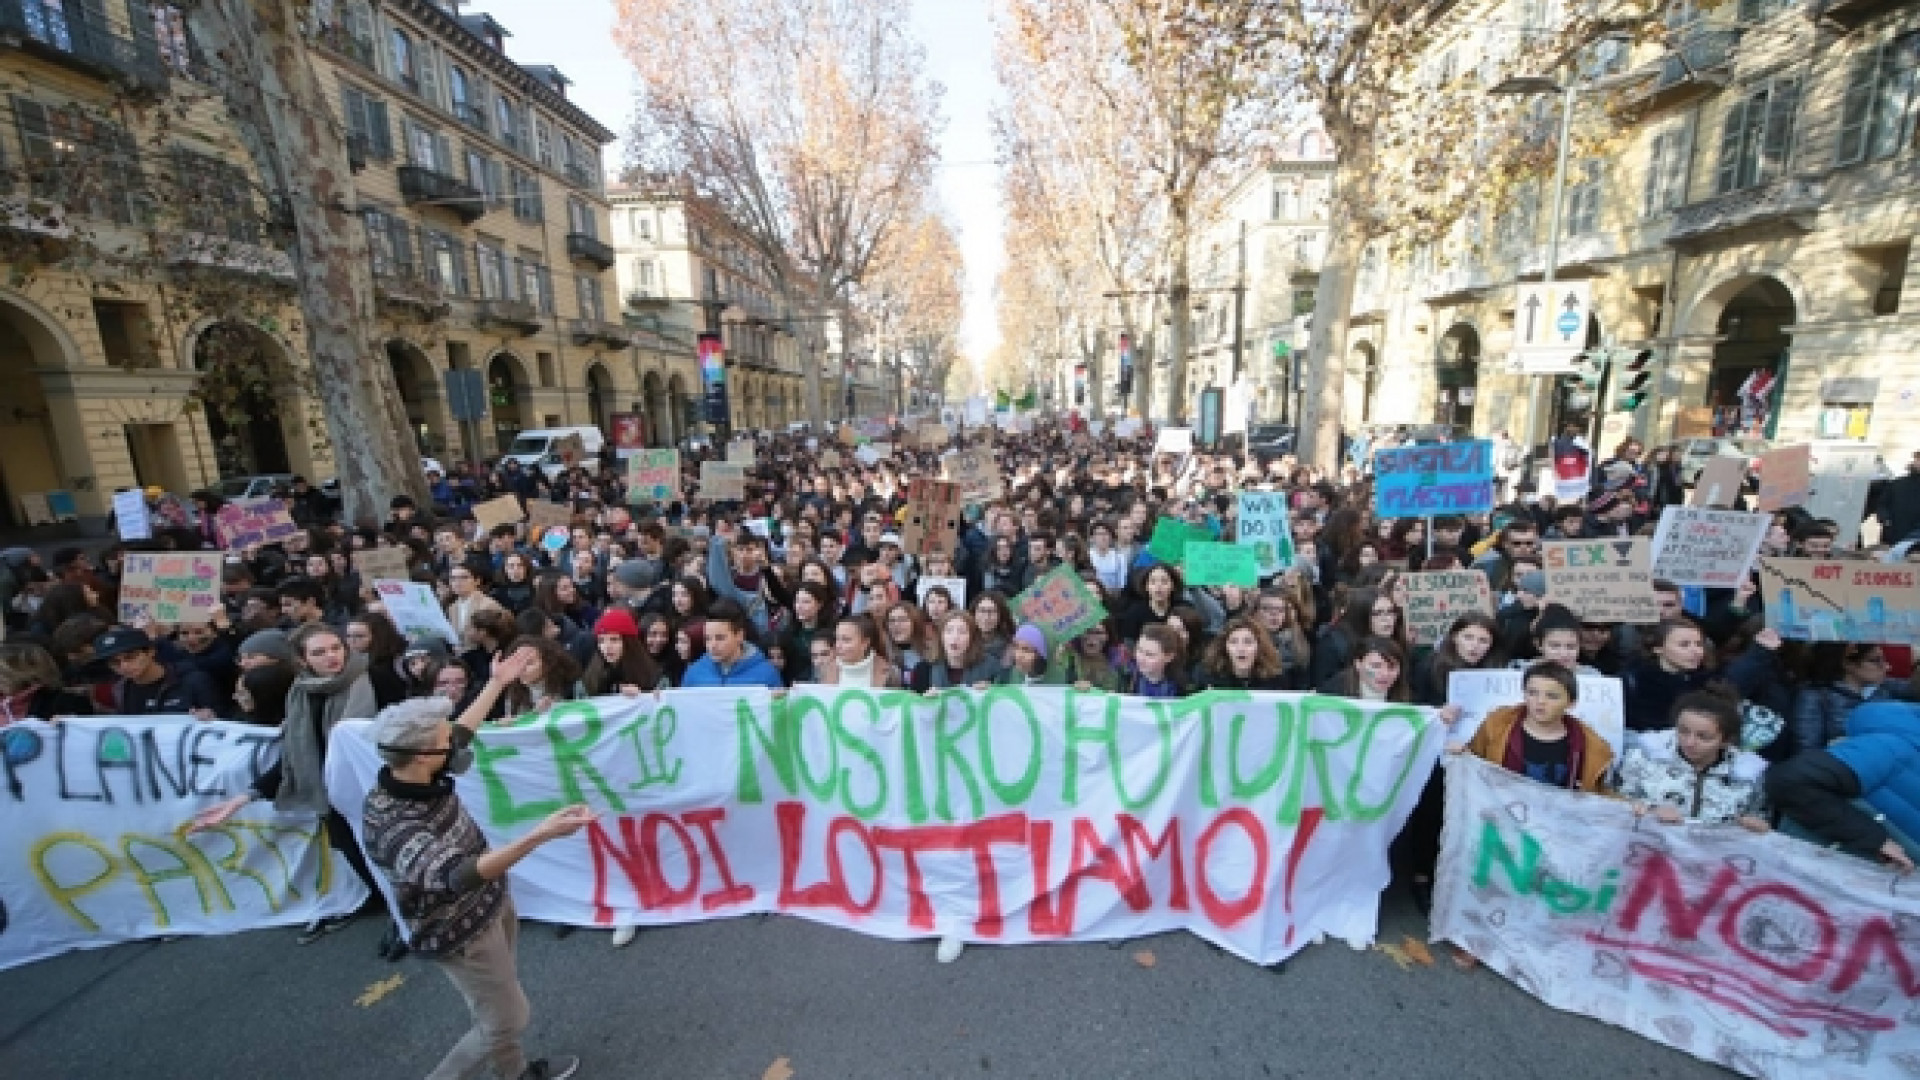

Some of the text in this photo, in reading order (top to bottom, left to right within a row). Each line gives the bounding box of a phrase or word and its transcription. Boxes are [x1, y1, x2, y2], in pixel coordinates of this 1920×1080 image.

[0, 720, 283, 804] PLANET
[736, 686, 1042, 823] NOSTRO
[1062, 687, 1428, 826] FUTURO
[588, 800, 1326, 948] NOI LOTTIAMO!
